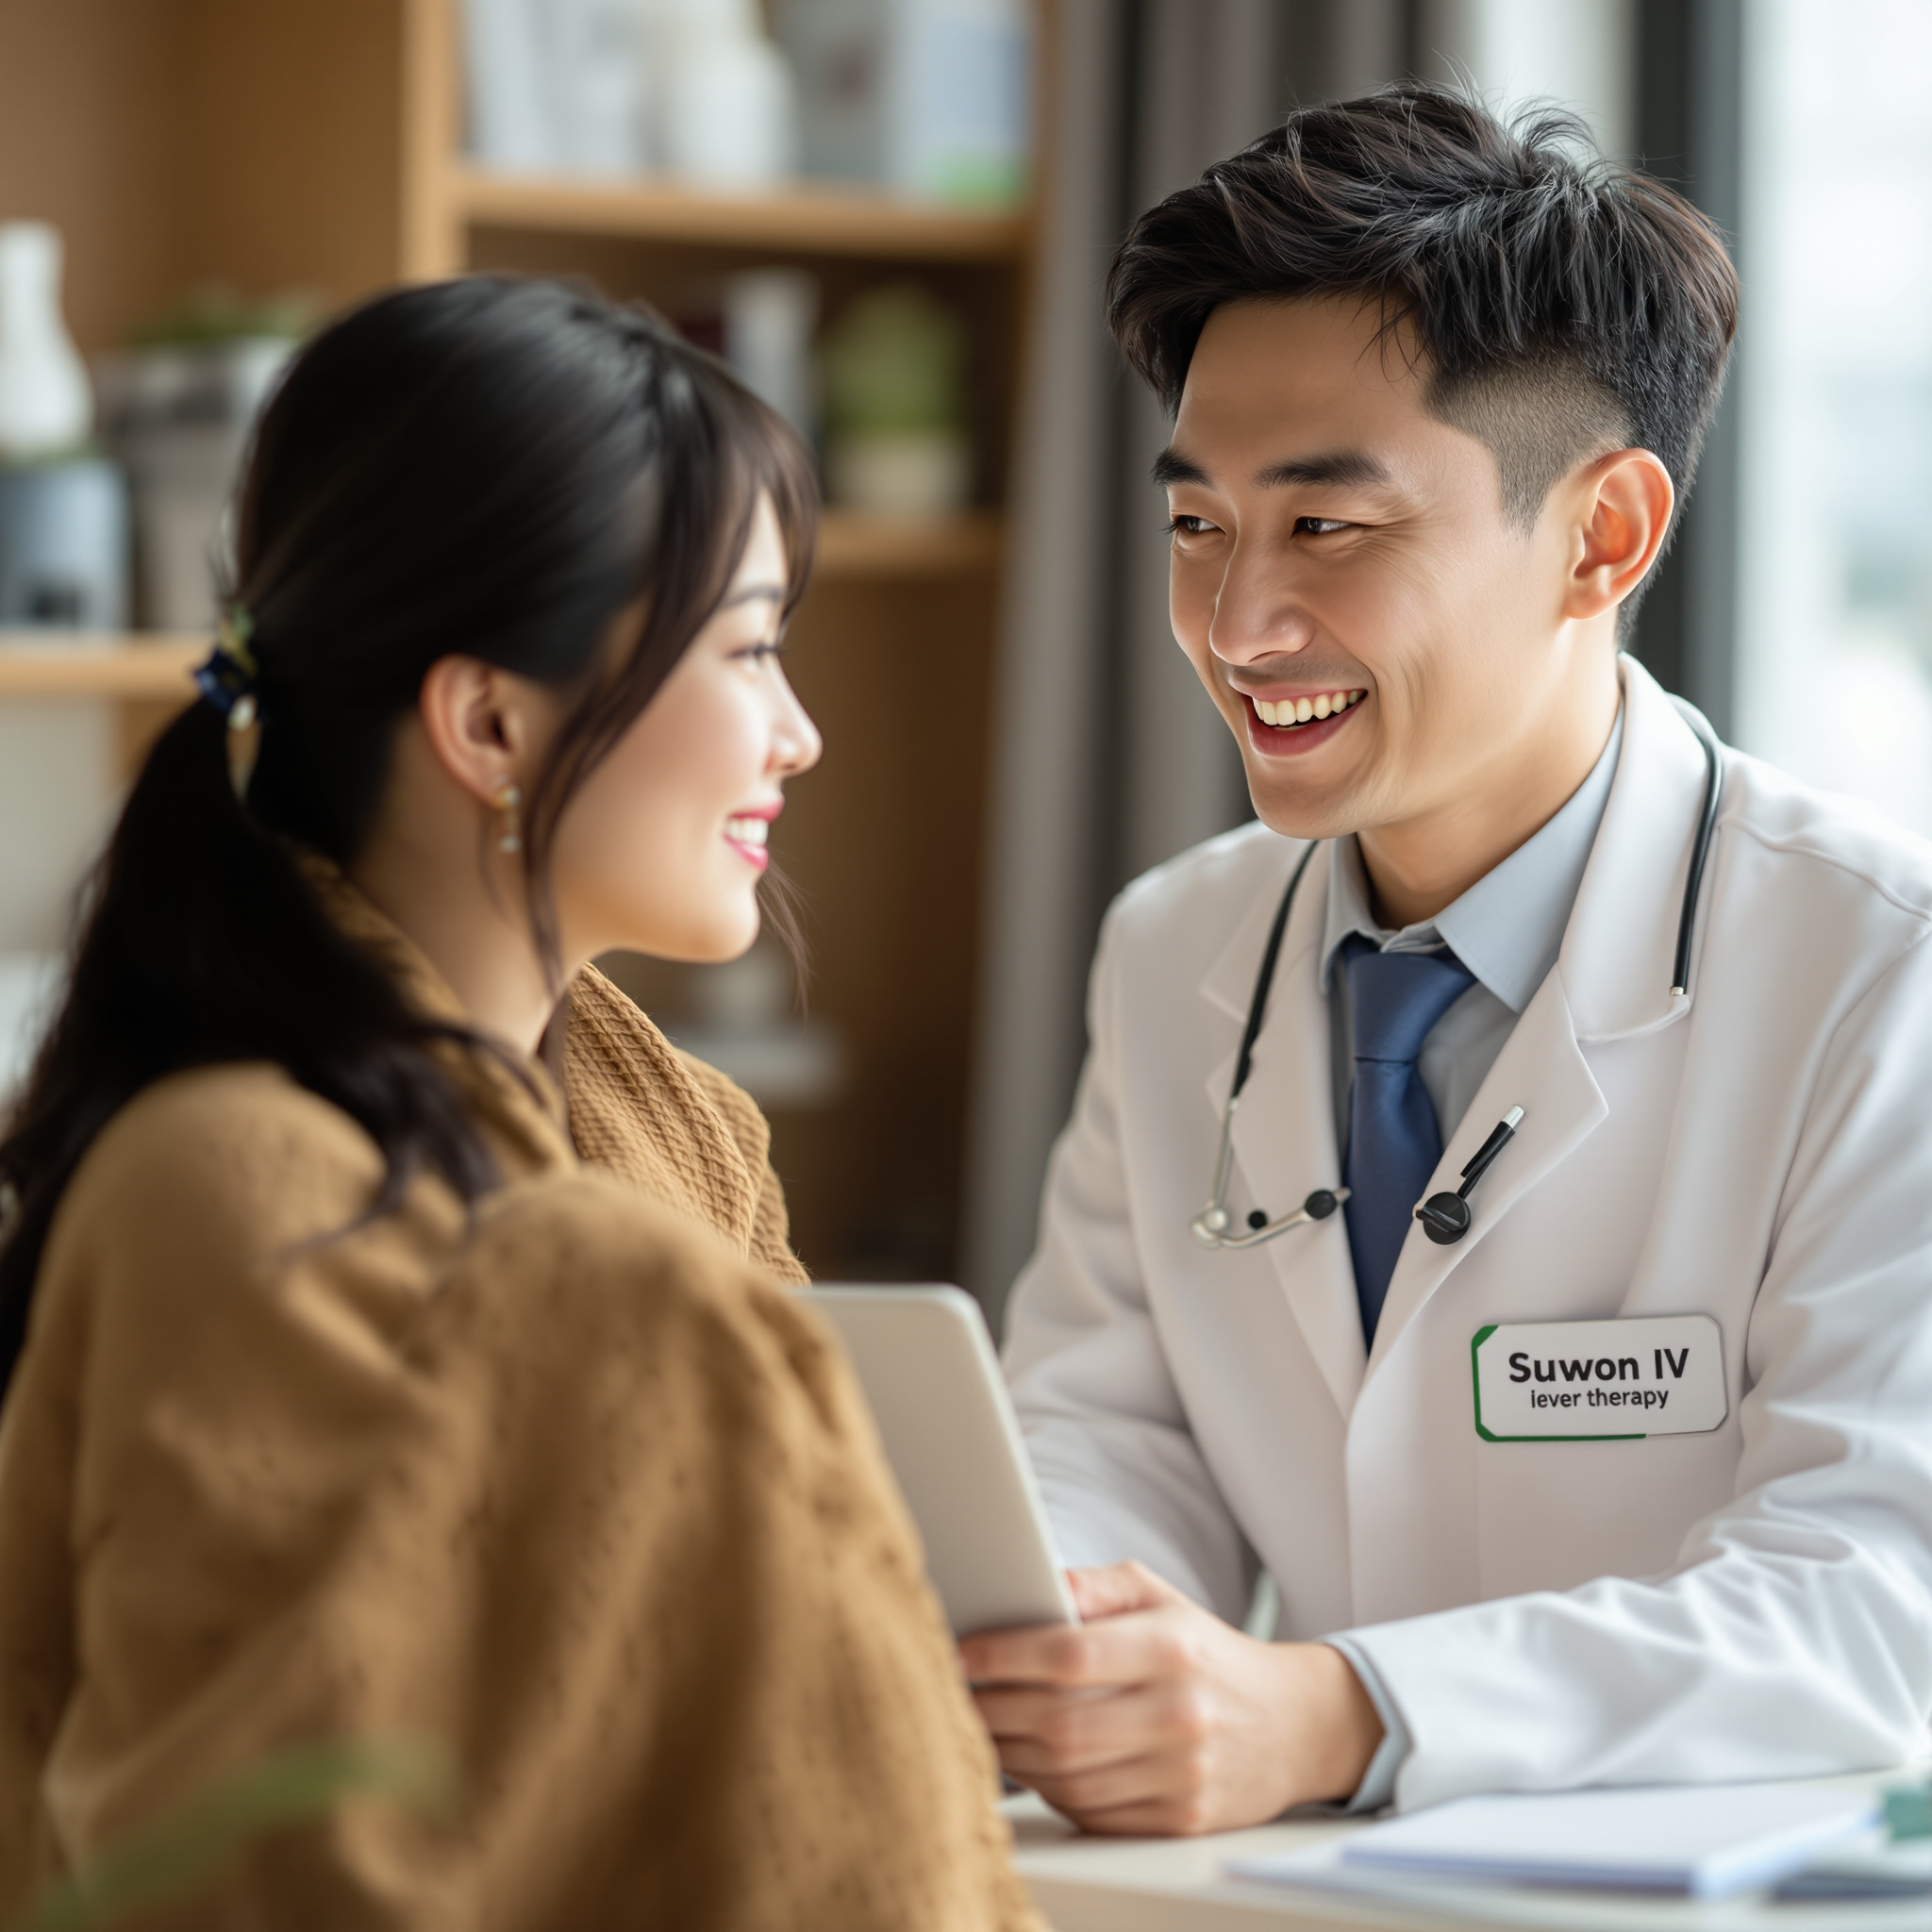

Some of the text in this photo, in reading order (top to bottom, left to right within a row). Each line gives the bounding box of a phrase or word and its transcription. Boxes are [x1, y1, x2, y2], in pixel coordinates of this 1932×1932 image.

[1508, 1348, 1690, 1383] Suwon IV
[1587, 1388, 1669, 1409] therapy
